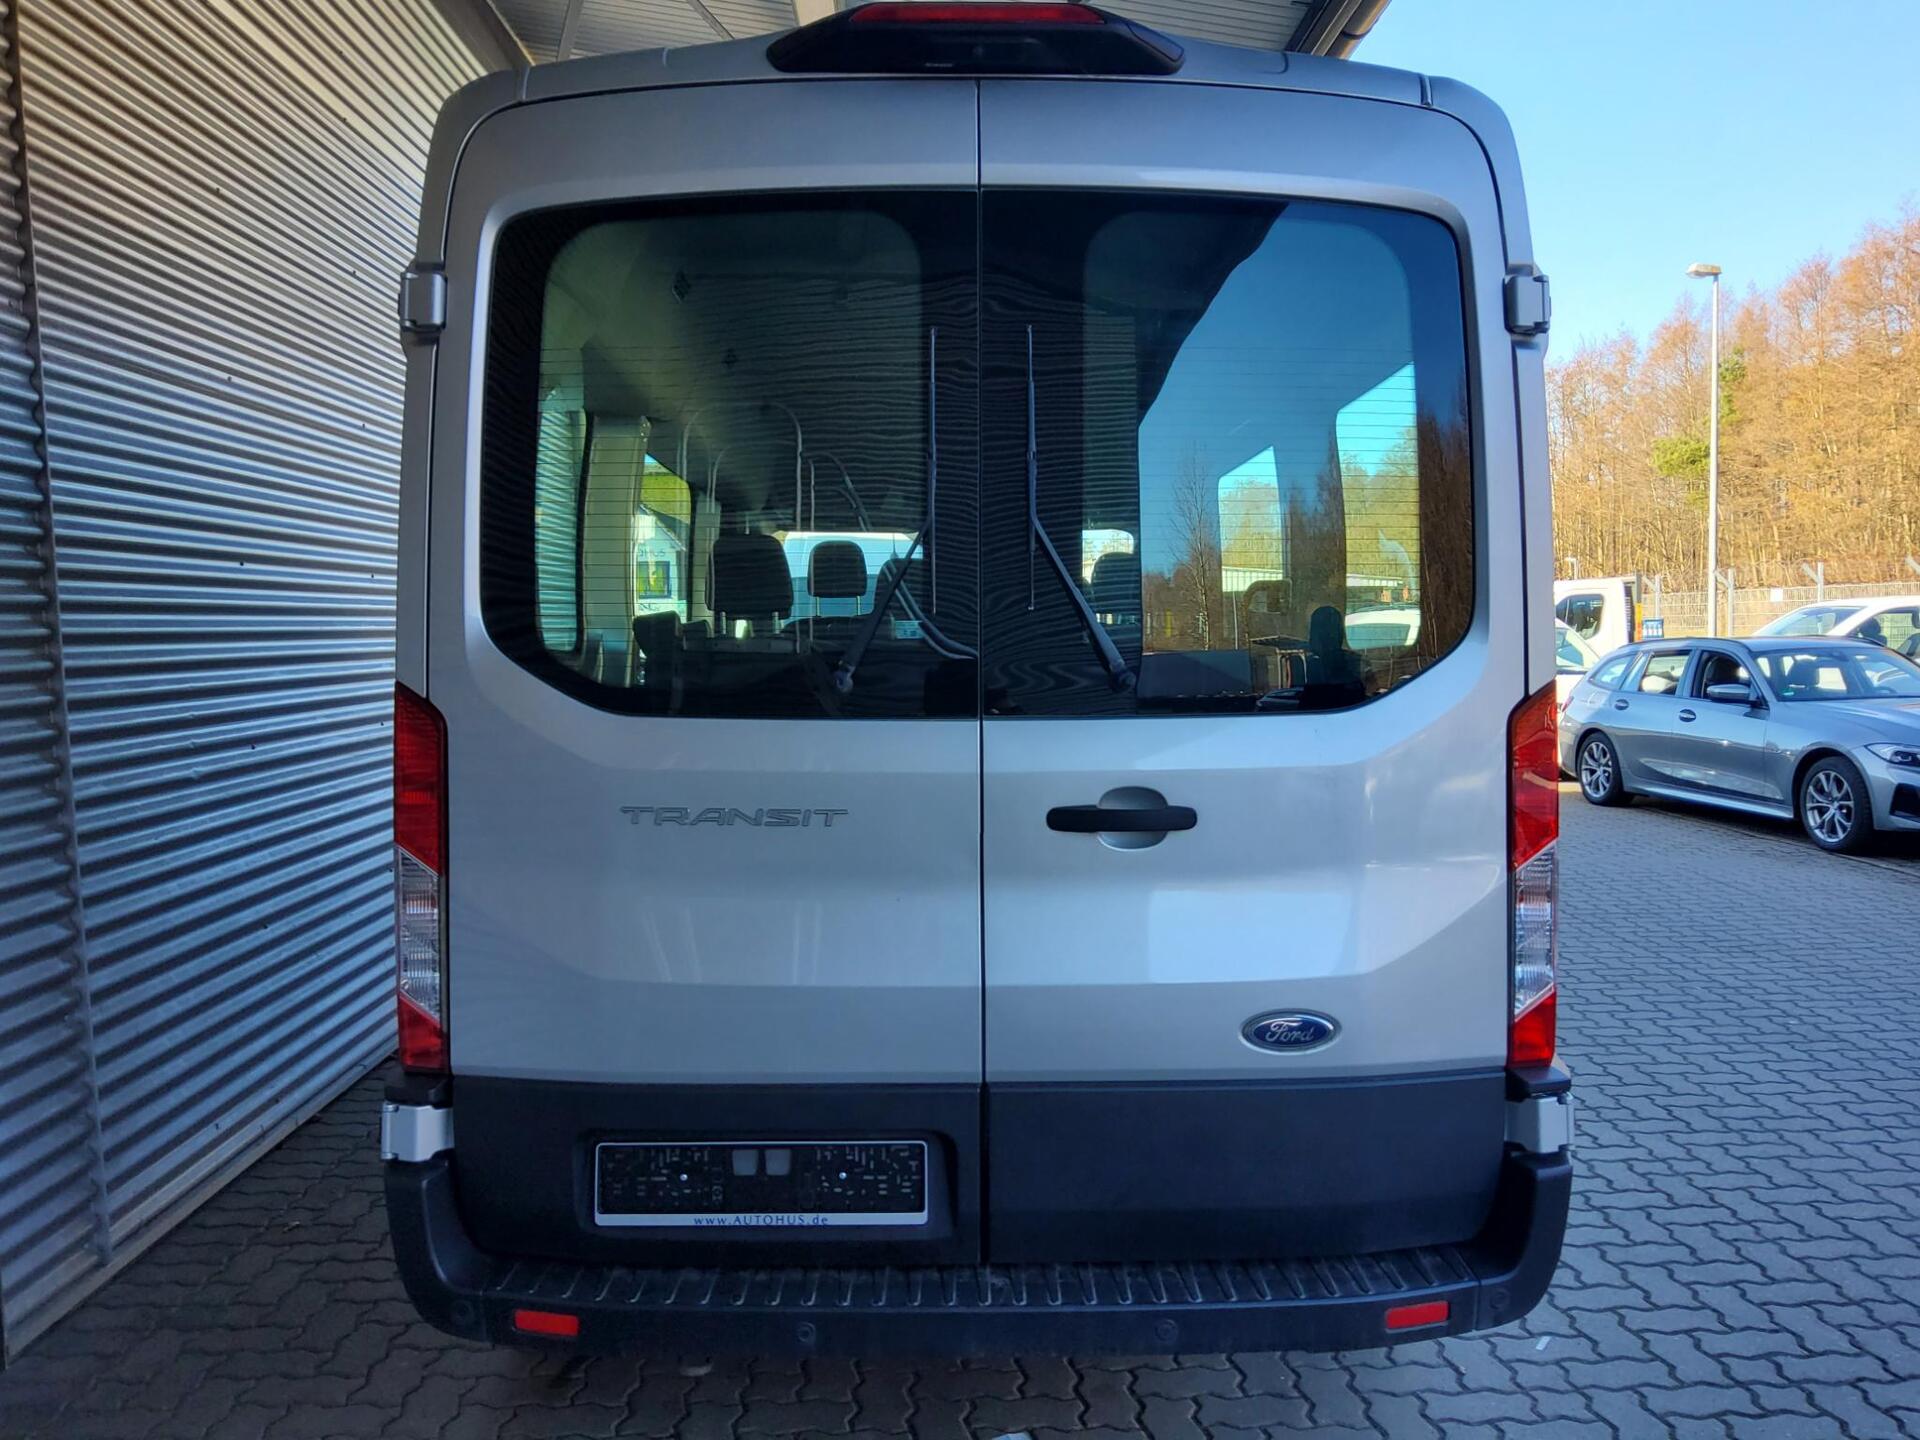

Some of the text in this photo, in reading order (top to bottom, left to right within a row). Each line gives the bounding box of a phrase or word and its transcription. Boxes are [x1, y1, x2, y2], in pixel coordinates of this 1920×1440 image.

[619, 805, 849, 827] TRANSIT
[1265, 1020, 1315, 1042] Ford
[693, 1214, 829, 1225] www.AUTOHUS.de
